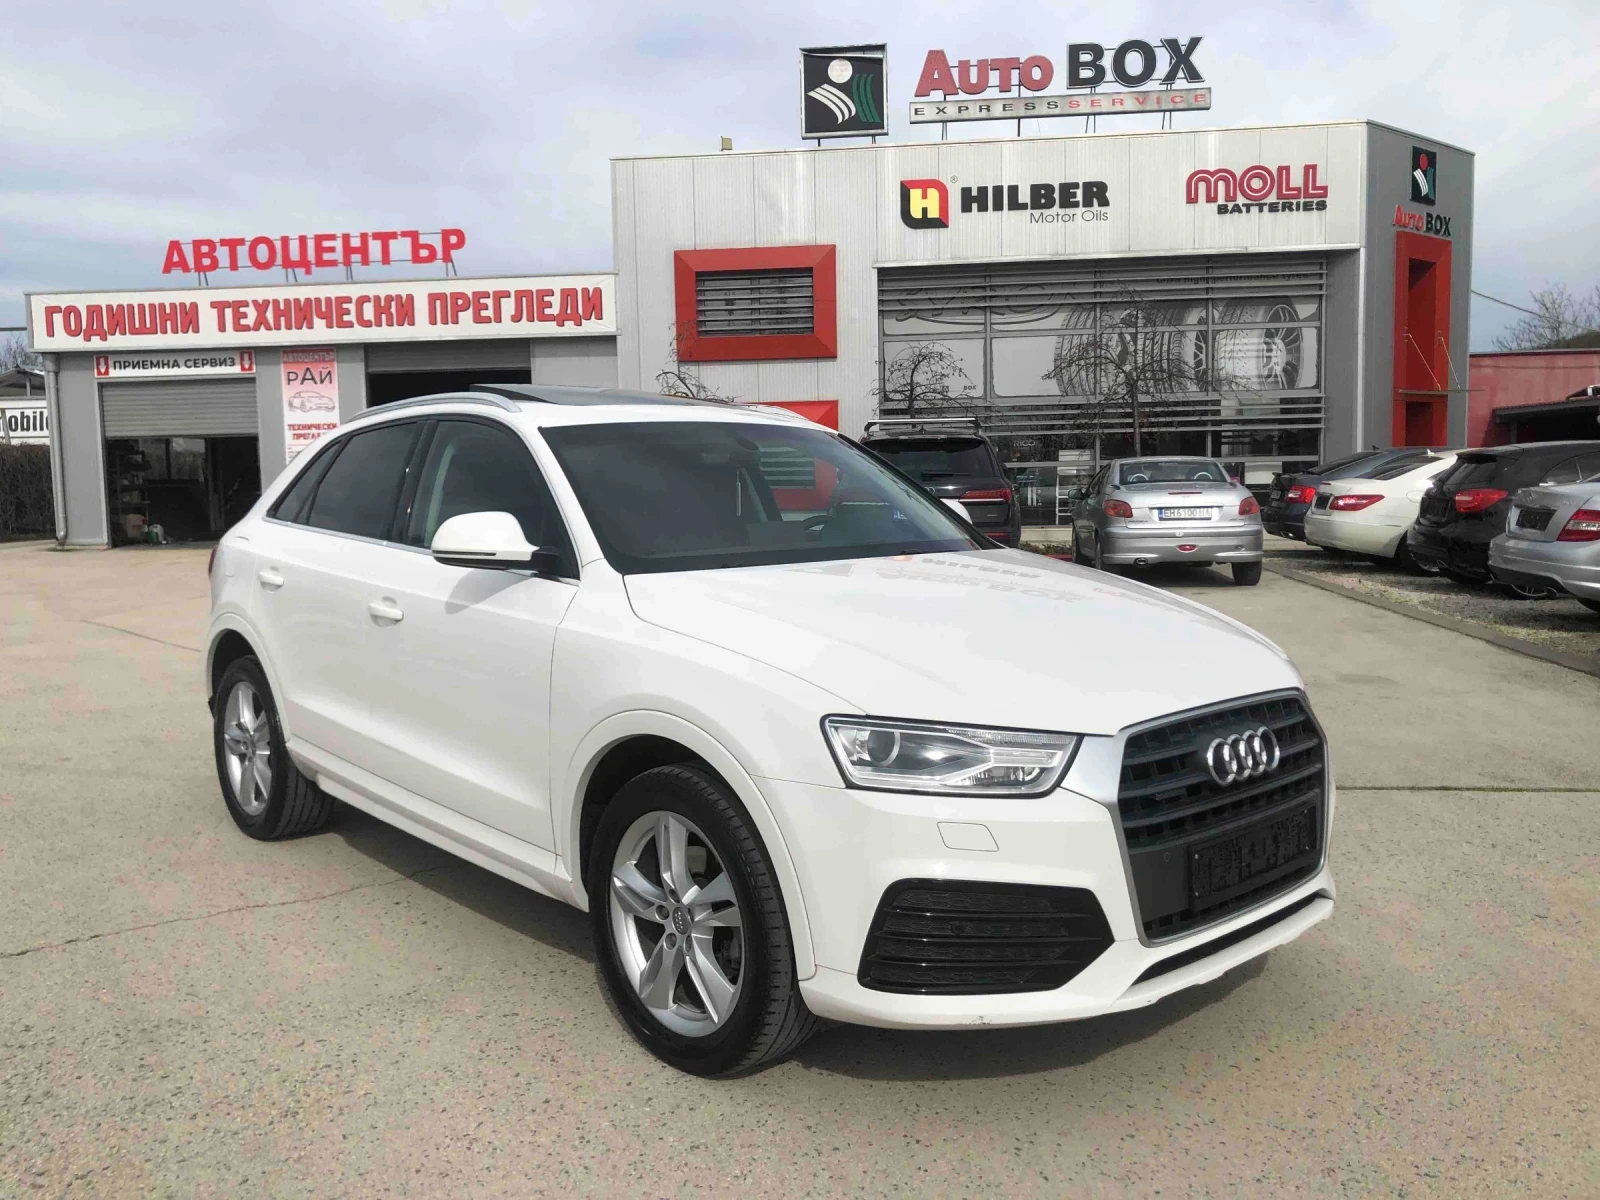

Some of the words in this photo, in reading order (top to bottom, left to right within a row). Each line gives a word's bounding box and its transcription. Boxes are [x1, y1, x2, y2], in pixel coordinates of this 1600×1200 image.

[1066, 35, 1206, 89] BOX
[960, 181, 1110, 213] HILBER
[1217, 200, 1328, 215] BATTERIES
[1030, 211, 1077, 224] Motor
[1081, 209, 1109, 222] Oils
[1425, 212, 1451, 237] BOX
[162, 229, 467, 275] АВТОЦЕНТЪР
[44, 302, 201, 342] ГОДИШНИ
[210, 294, 416, 333] ТЕХНИЧЕСКИ
[427, 287, 604, 327] ПРЕГЛЕДИ
[113, 359, 181, 370] ПРИЕМНА
[184, 357, 236, 369] СЕРВИЗ
[287, 366, 333, 386] РАЙ
